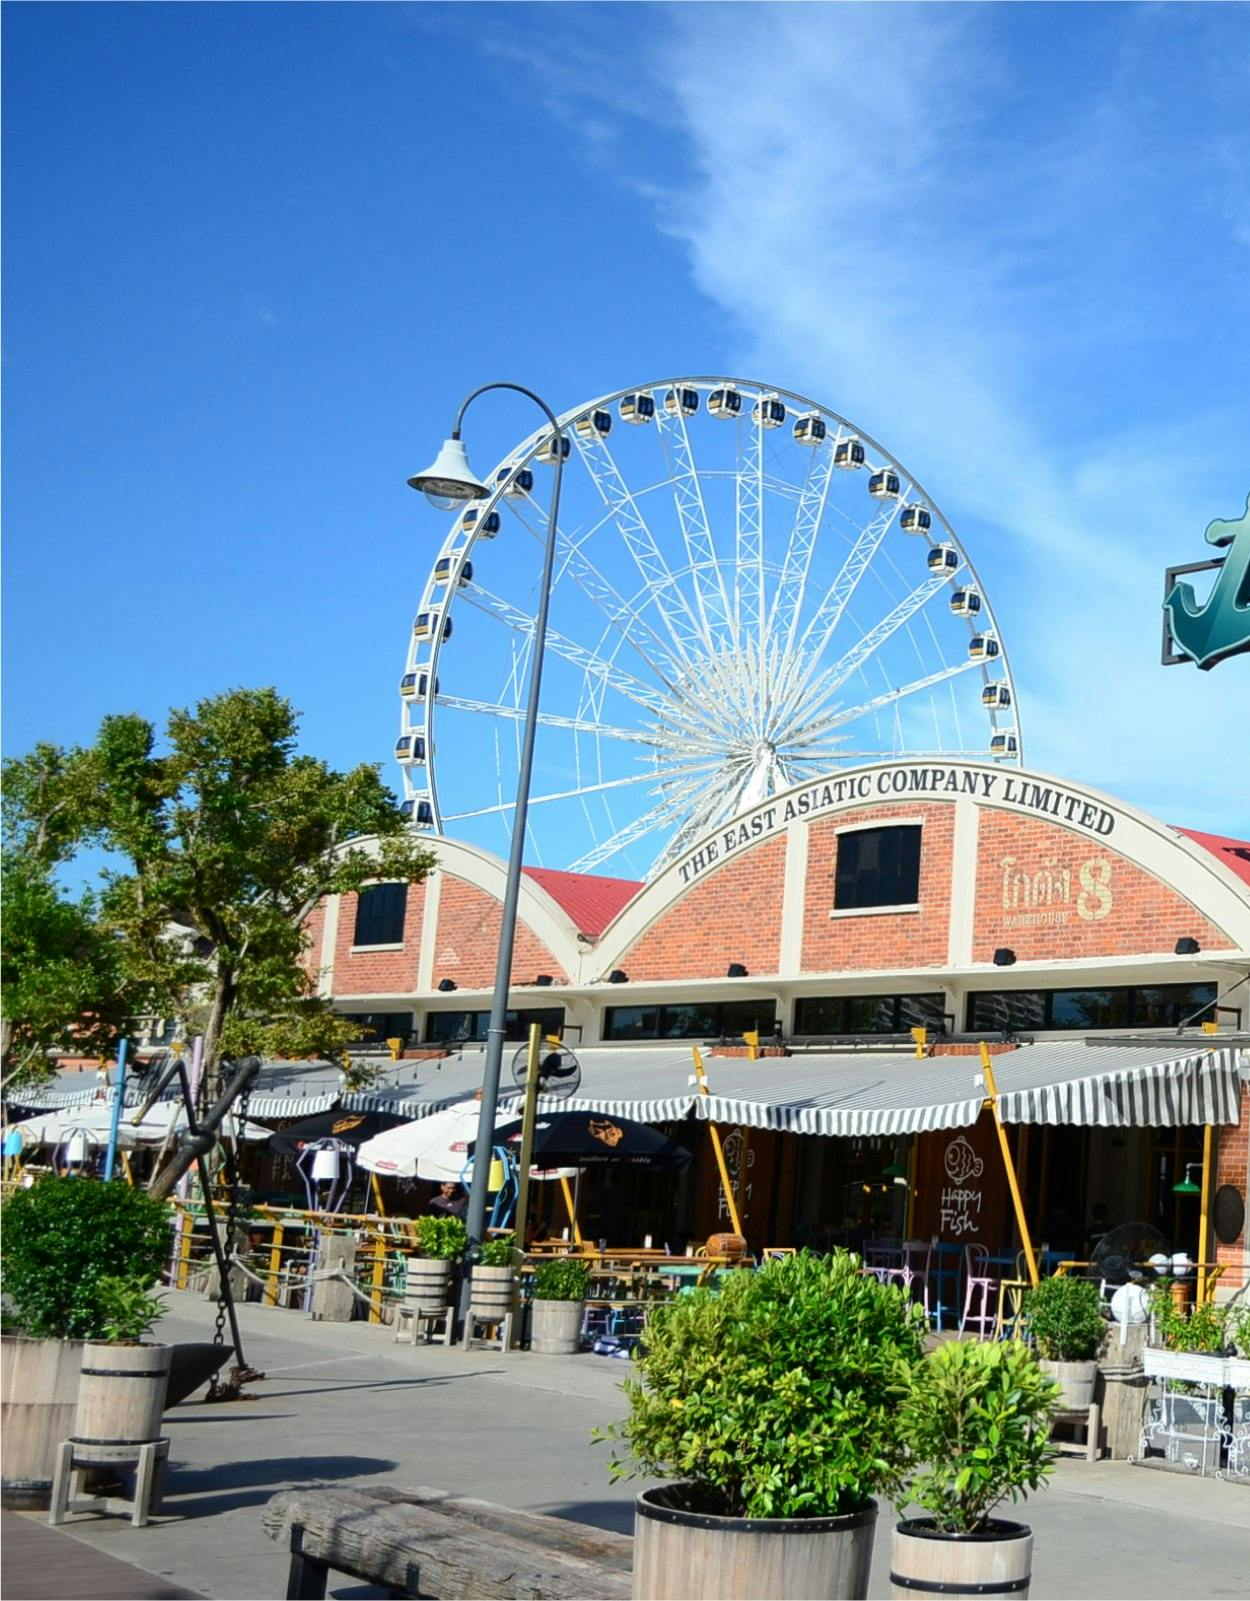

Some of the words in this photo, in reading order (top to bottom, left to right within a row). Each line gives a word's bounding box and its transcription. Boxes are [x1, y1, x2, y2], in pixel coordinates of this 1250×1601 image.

[677, 840, 719, 885] THE
[722, 808, 777, 851] EAST
[782, 775, 872, 822] ASIATIC
[876, 768, 999, 798] COMPANY
[1001, 777, 1116, 837] LIMITED
[1077, 856, 1113, 921] 8
[940, 1209, 979, 1236] Fish
[941, 1187, 982, 1213] Happy
